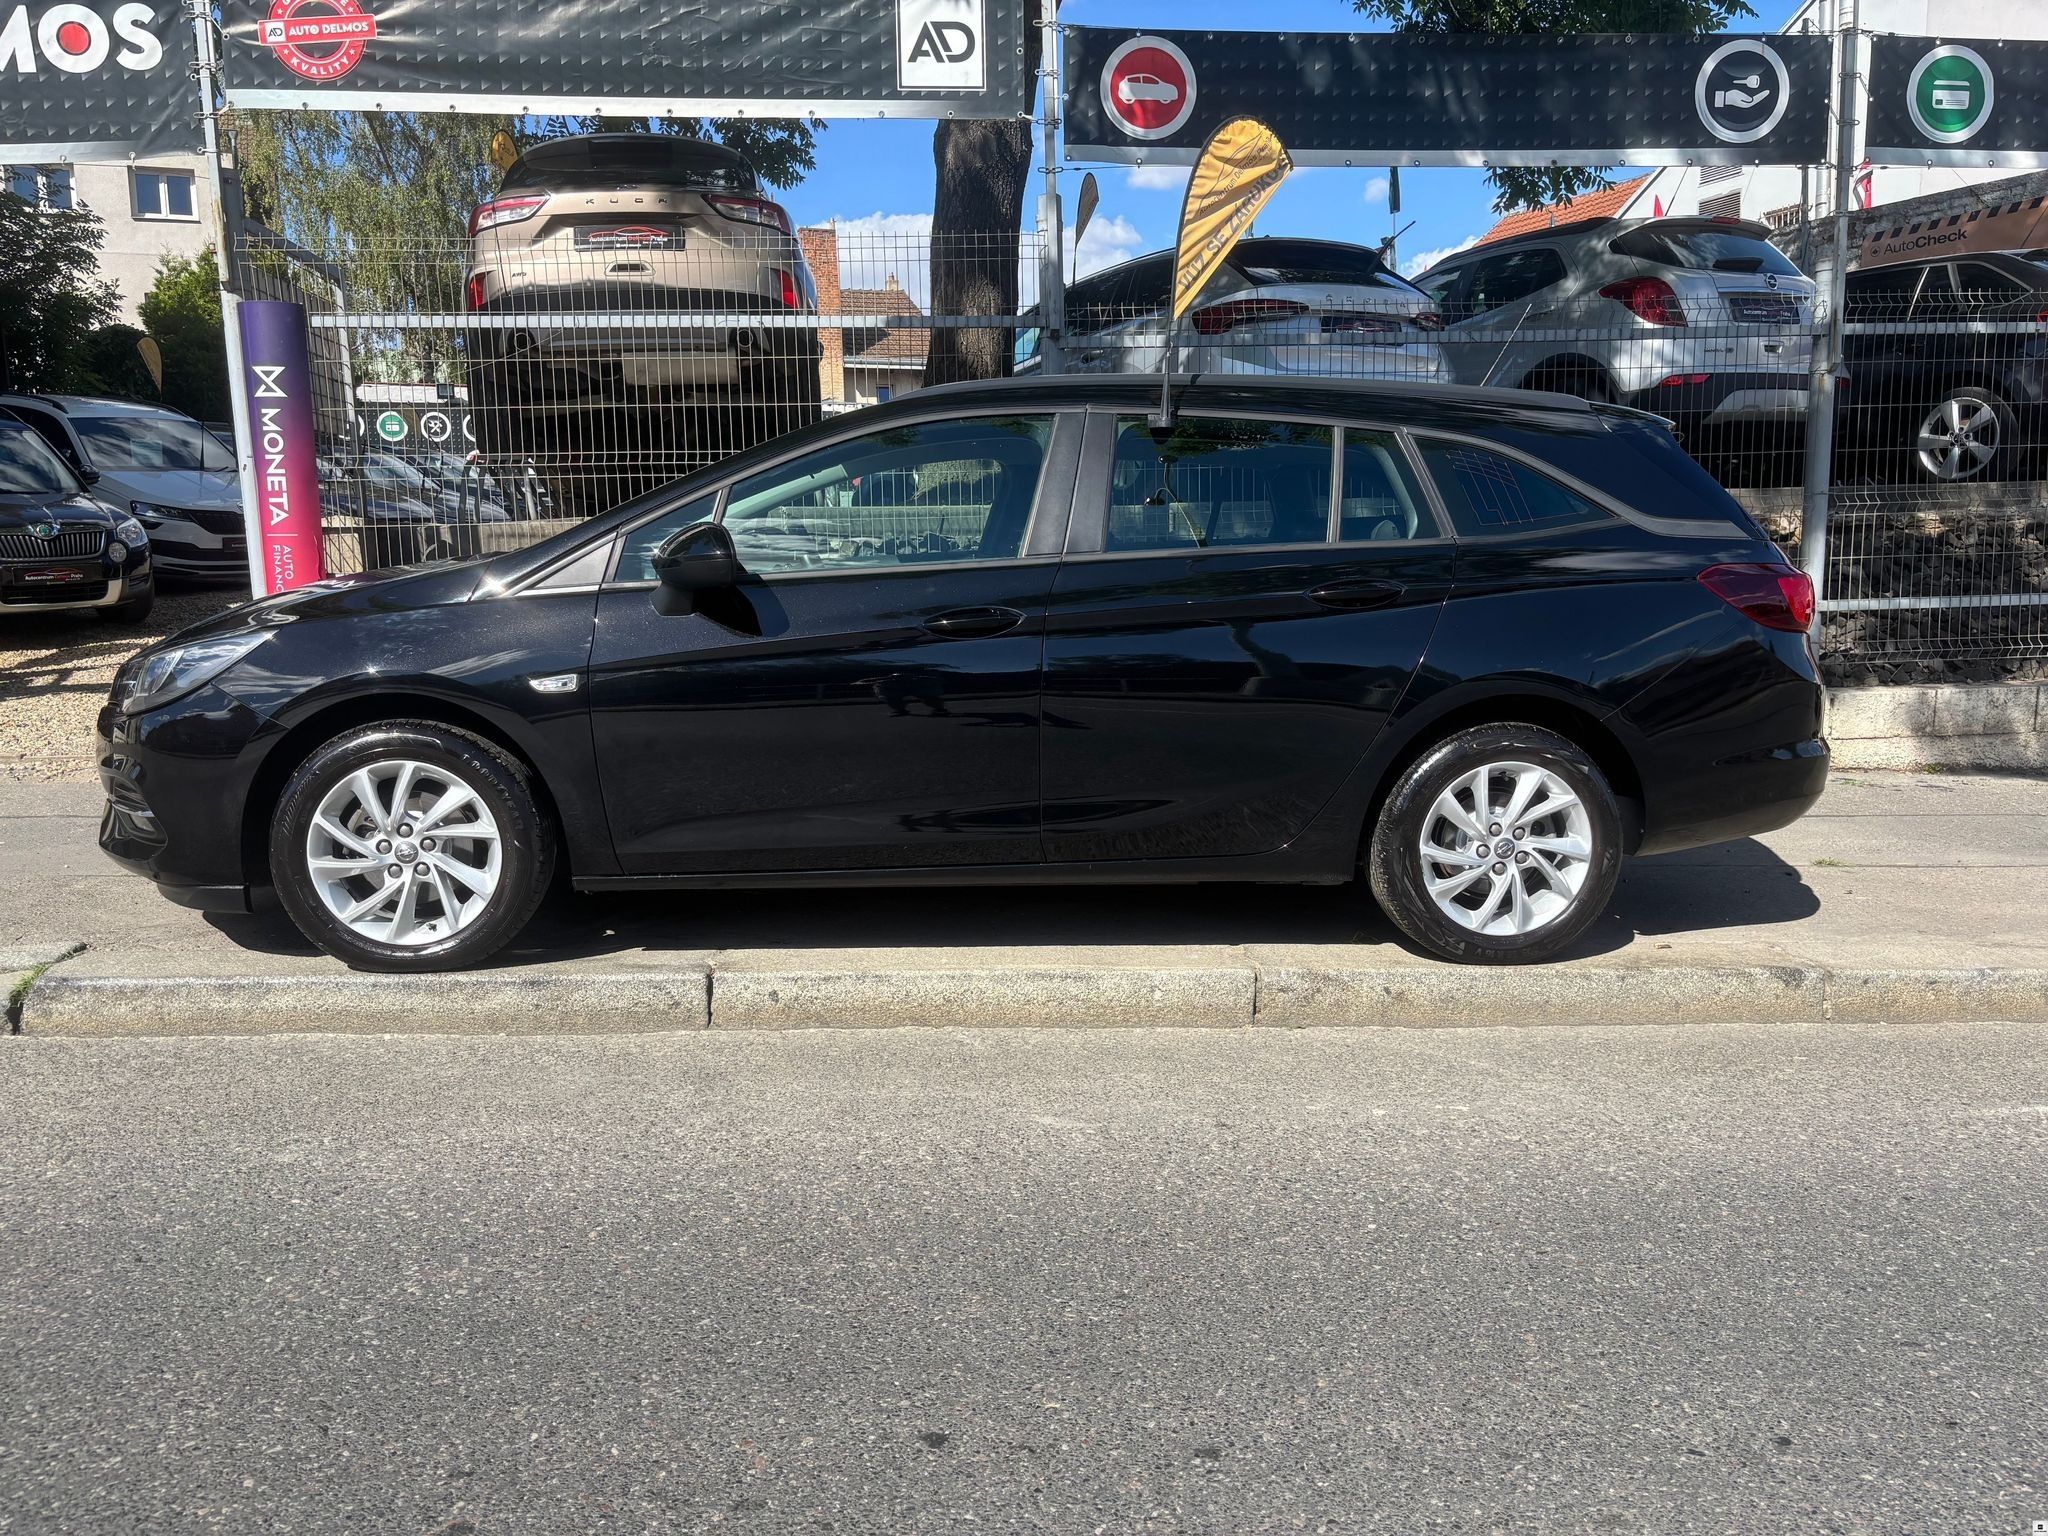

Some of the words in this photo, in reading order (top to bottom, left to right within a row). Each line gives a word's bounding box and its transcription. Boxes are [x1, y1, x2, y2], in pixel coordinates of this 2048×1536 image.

[288, 25, 319, 36] AUTO
[321, 21, 369, 34] DELMOS
[907, 21, 975, 63] AD
[290, 56, 350, 75] KVALITY
[1206, 229, 1228, 255] SE
[1884, 229, 1968, 255] AutoCheck
[261, 408, 290, 526] MONETA
[282, 545, 294, 580] AUTO
